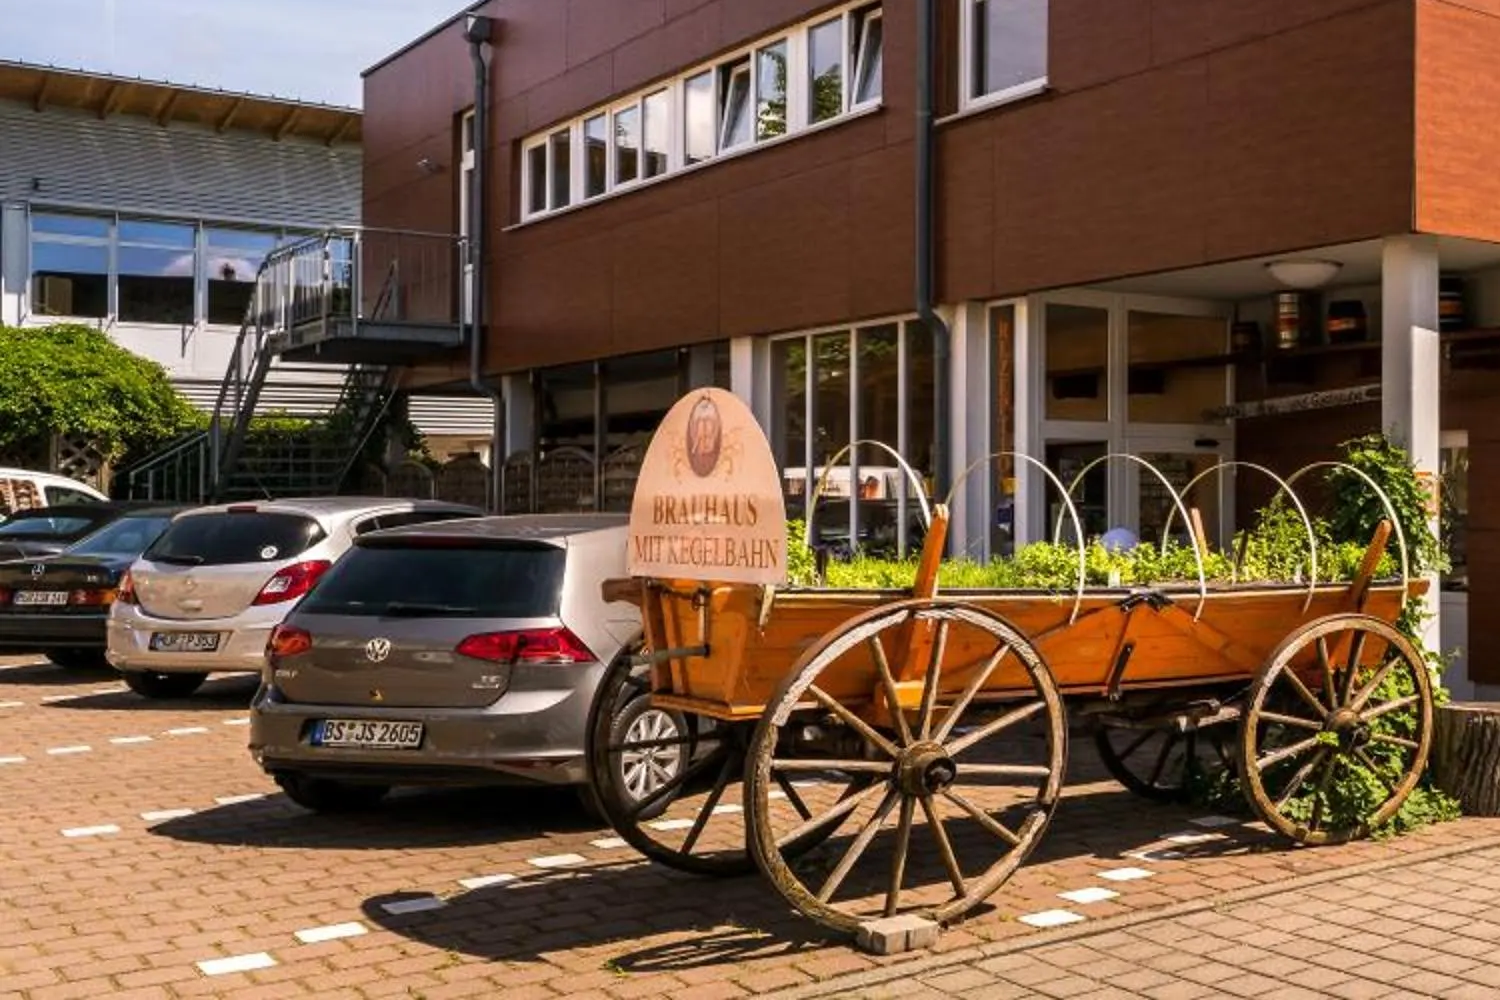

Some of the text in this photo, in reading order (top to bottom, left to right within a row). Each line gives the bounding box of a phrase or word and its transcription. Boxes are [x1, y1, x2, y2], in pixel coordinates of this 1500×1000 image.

[653, 495, 758, 526] BRAUHAUS
[635, 535, 779, 568] MIT KEGELBAHN
[378, 723, 420, 744] 2605
